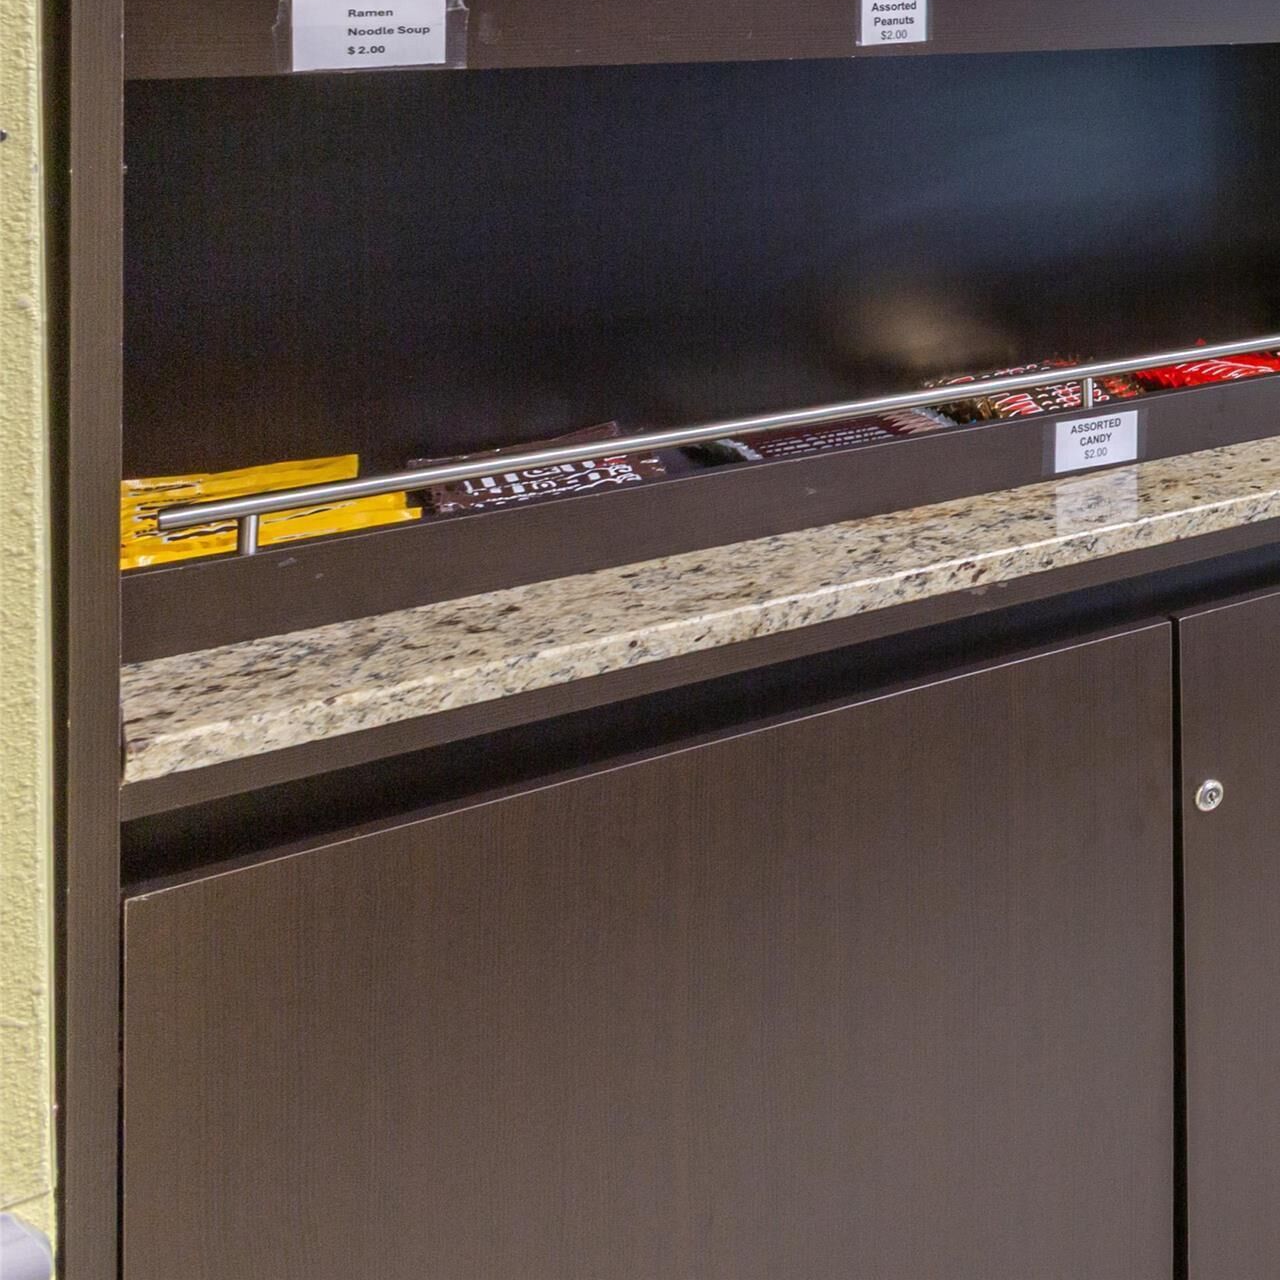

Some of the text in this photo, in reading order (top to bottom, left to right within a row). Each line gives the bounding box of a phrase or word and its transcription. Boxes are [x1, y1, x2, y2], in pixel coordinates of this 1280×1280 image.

[347, 8, 394, 18] Ramen
[871, 0, 917, 13] Assorted
[873, 14, 915, 27] Peanuts
[347, 25, 431, 37] Noodle Soup
[880, 29, 908, 41] $2.00
[357, 45, 386, 55] 2.00
[1070, 417, 1122, 434] ASSORTED
[1079, 432, 1113, 447] CANDY
[1084, 447, 1108, 460] $2.00
